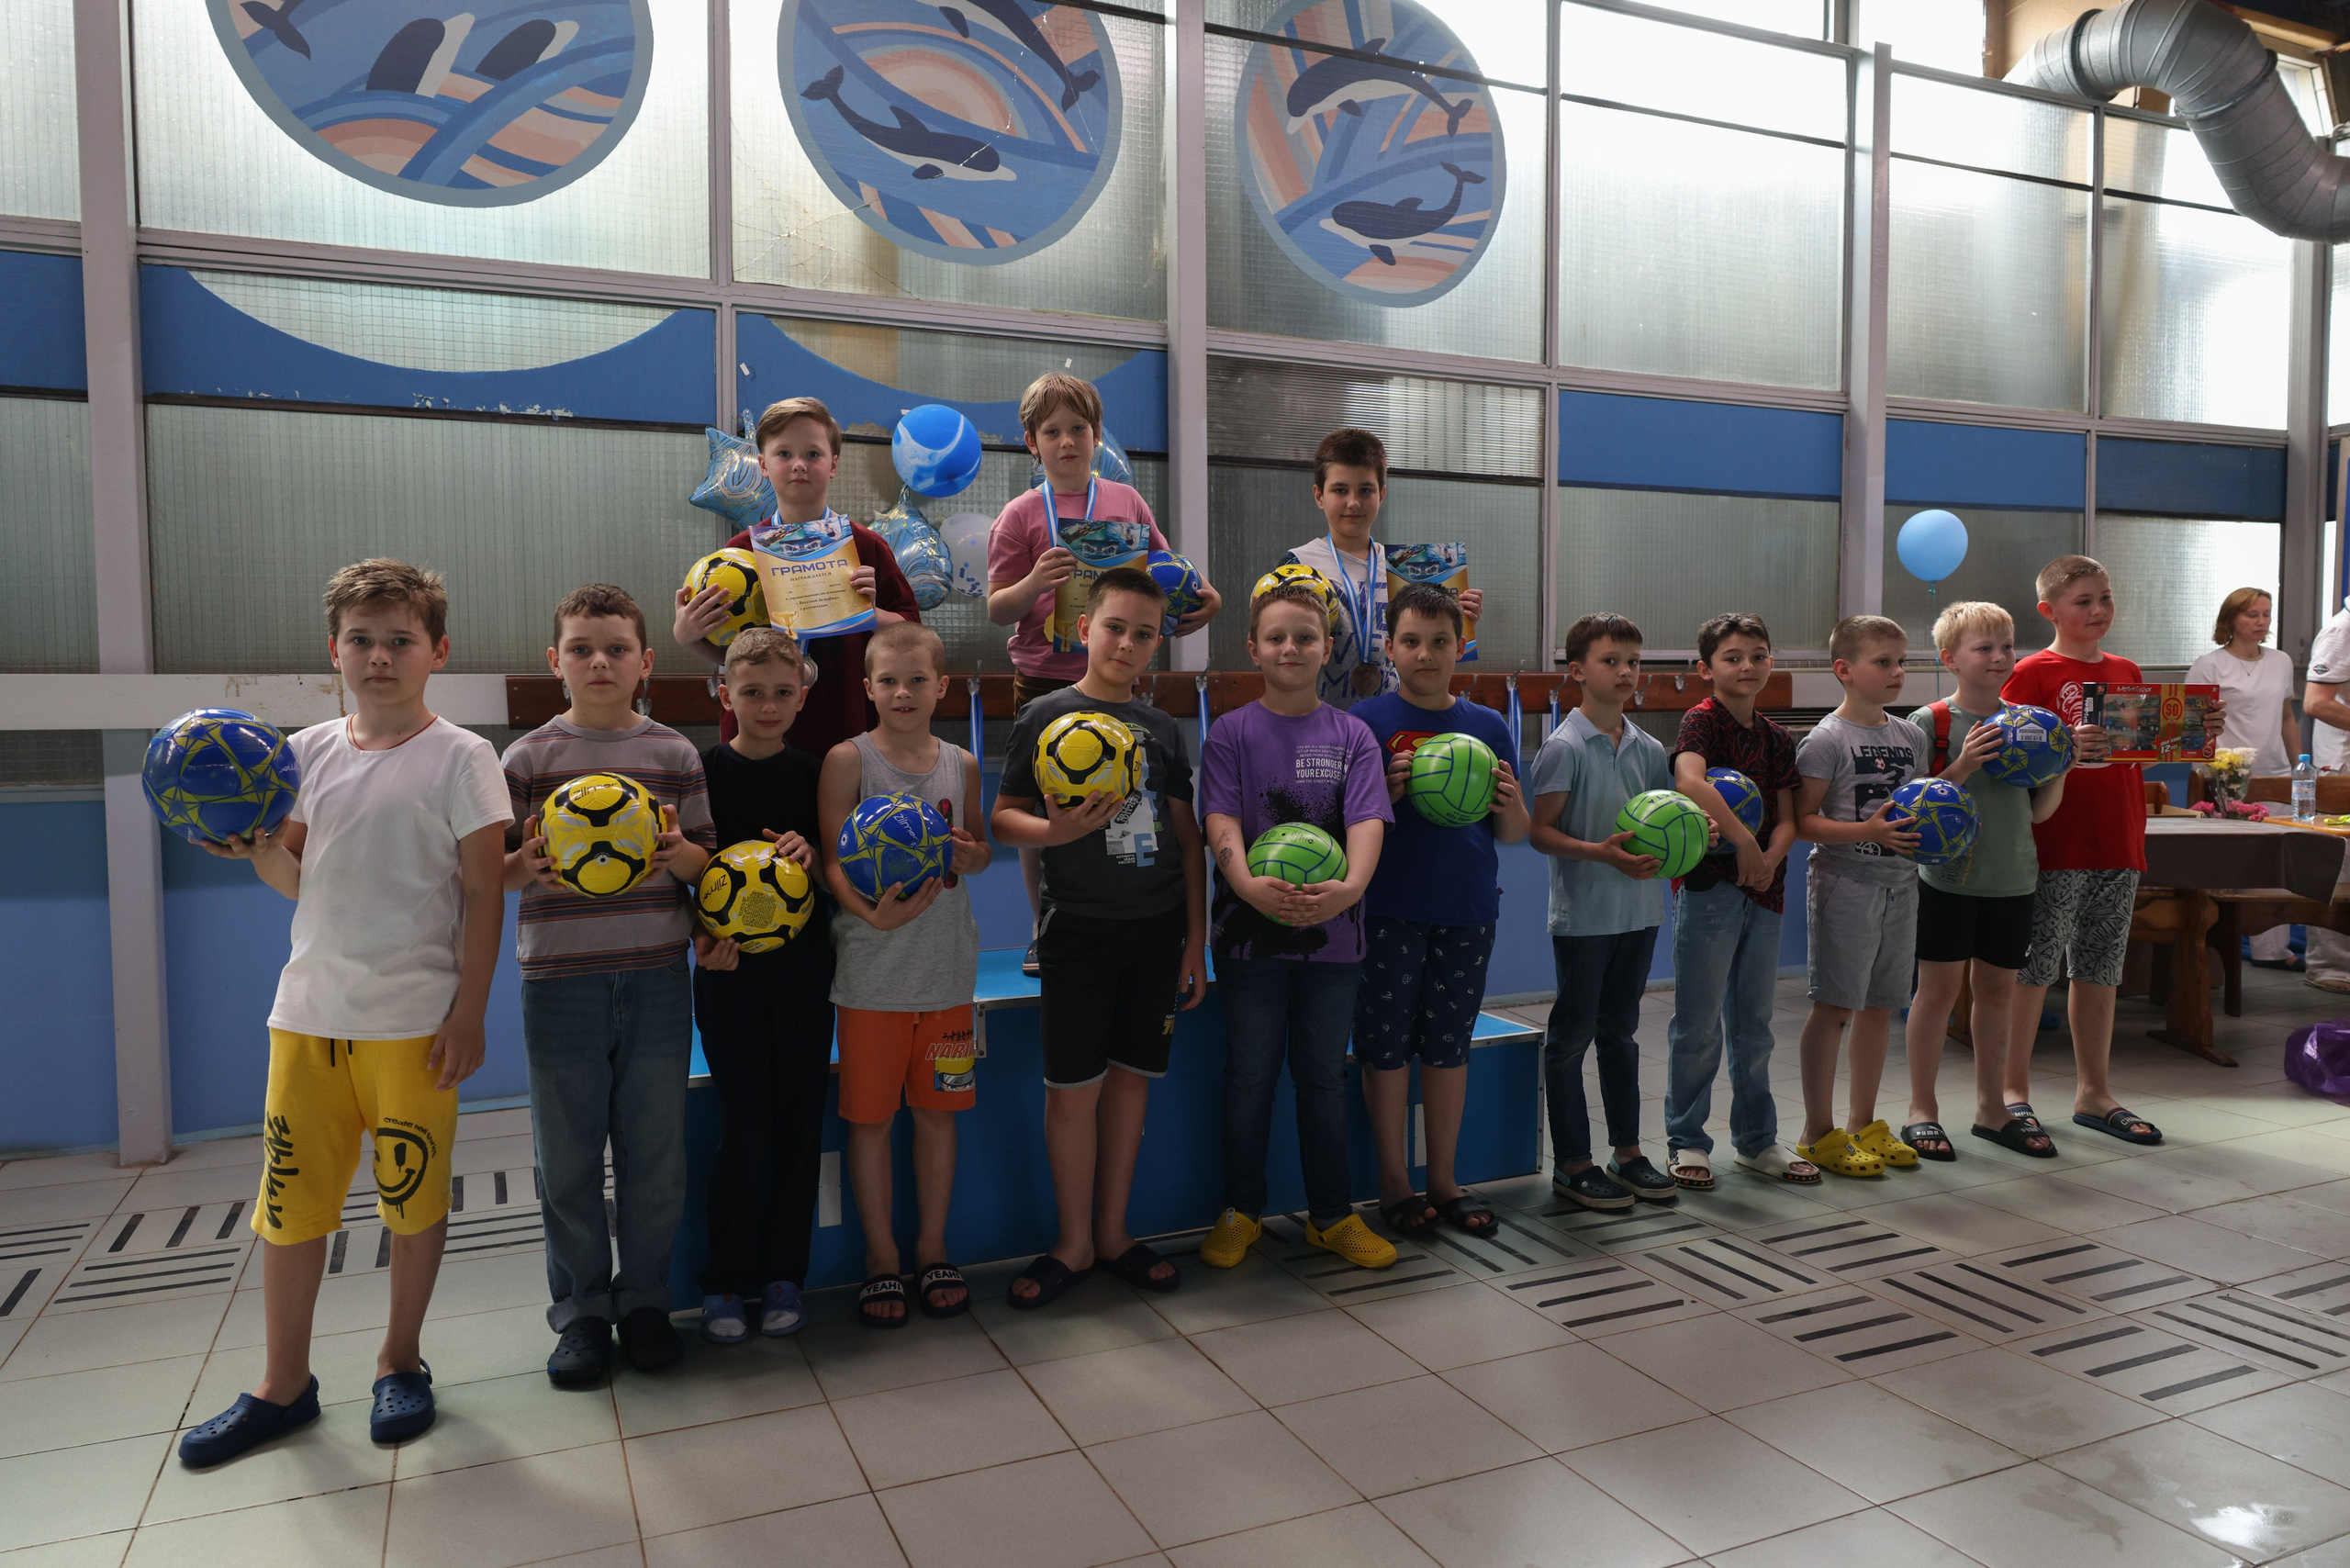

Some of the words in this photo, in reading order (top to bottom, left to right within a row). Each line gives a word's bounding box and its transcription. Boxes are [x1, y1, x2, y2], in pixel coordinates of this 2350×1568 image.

[771, 559, 848, 576] ГРАМОТА
[789, 572, 832, 582] НАГРАЖДАЕТСЯ
[2166, 703, 2179, 717] SQ
[1851, 745, 1913, 758] LEGENDS
[2161, 745, 2171, 754] 12
[1296, 758, 1304, 767] BE
[1306, 758, 1342, 770] STRONGER
[1296, 769, 1315, 778] YOUR
[573, 782, 618, 801] zilmer
[892, 813, 920, 842] zilmer
[702, 874, 728, 903] zilmer
[925, 1038, 974, 1061] NARU
[384, 1117, 413, 1127] create
